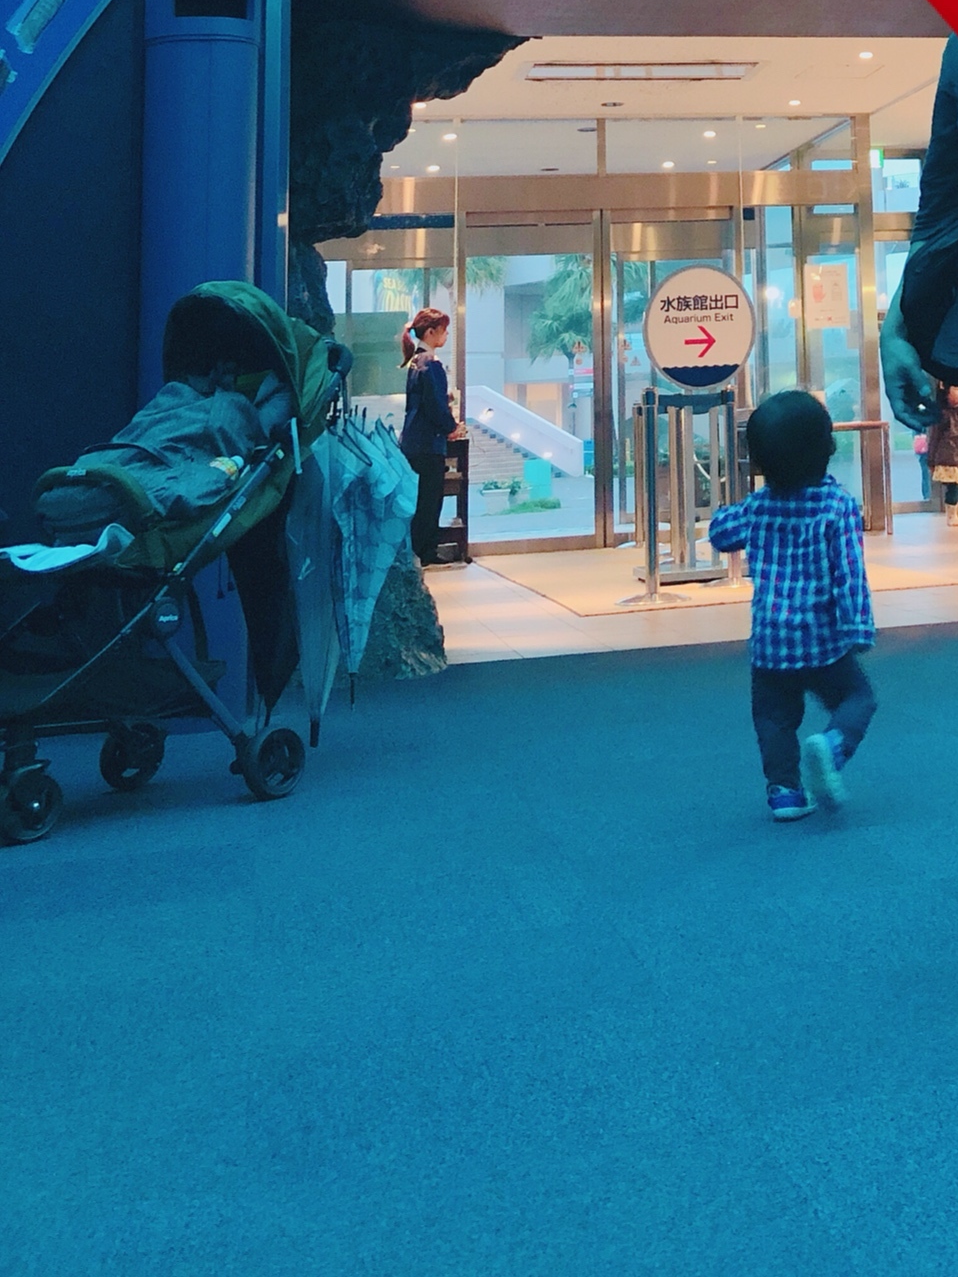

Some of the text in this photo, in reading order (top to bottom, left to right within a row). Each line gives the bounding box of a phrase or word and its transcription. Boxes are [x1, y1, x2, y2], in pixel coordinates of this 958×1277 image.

[660, 294, 739, 312] 水族館出口
[664, 312, 734, 324] Aquarium Exit
